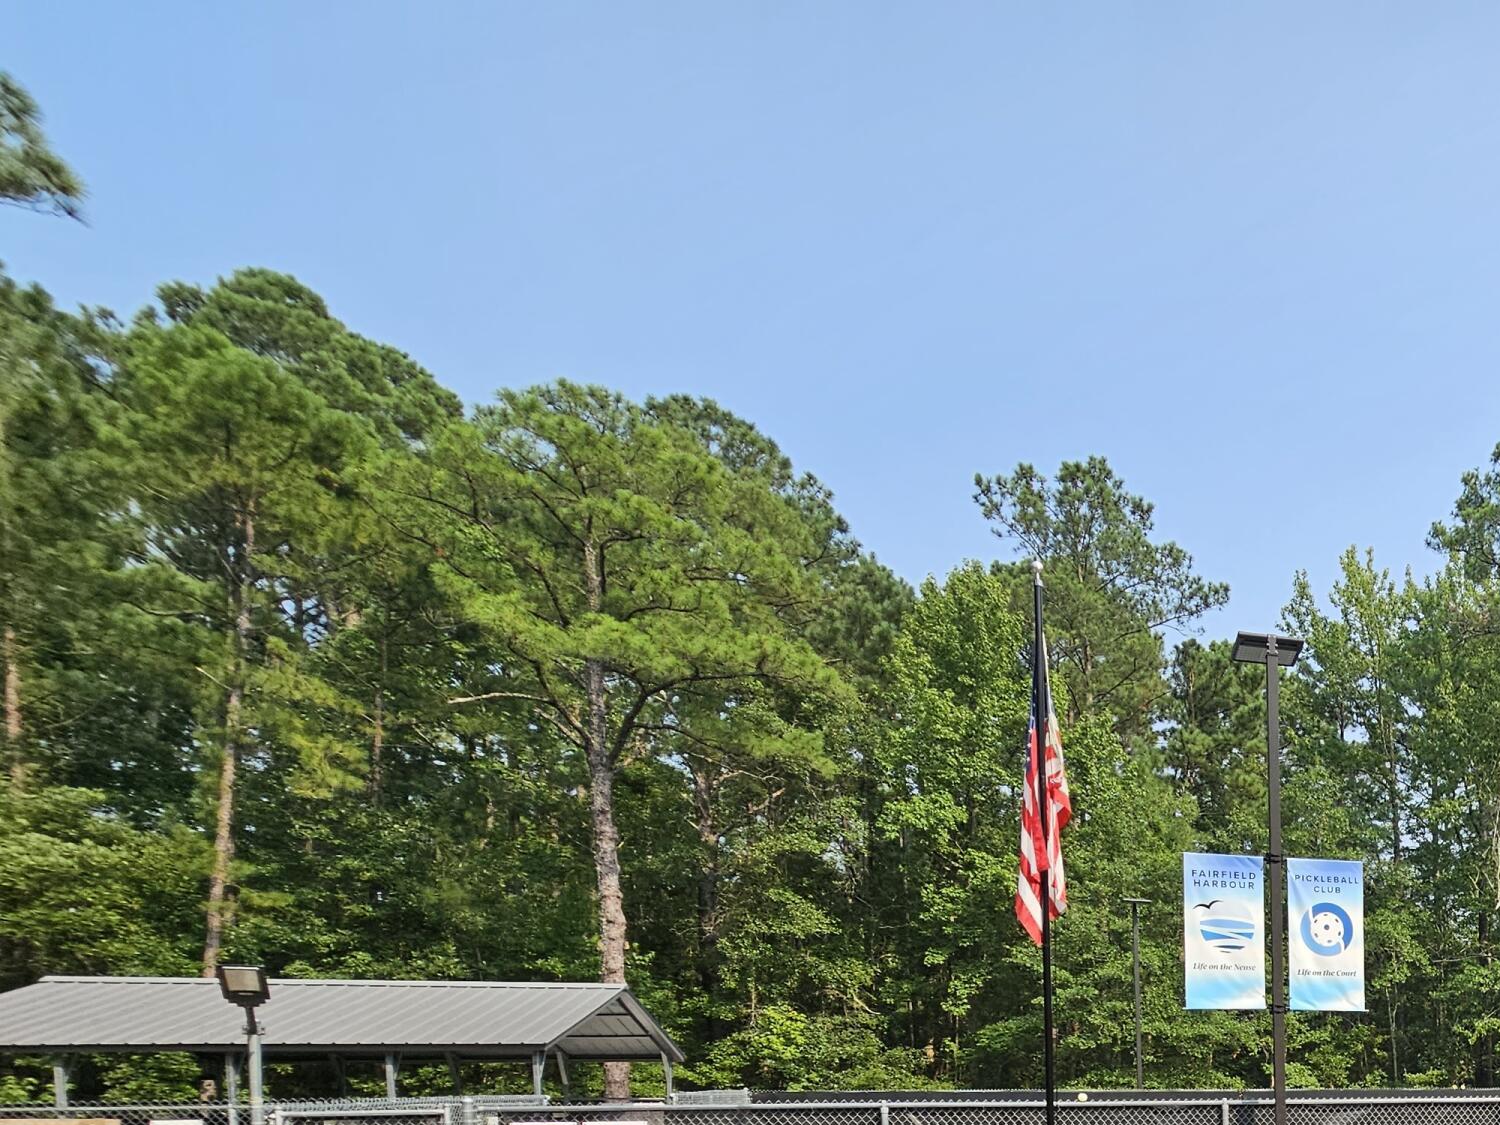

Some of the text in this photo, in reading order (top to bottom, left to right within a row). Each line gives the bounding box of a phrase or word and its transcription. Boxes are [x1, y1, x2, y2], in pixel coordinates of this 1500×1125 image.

[1191, 869, 1256, 880] FAIRFIELD
[1294, 874, 1359, 884] PICKLEBALL
[1193, 880, 1255, 889] HARBOUR
[1313, 886, 1341, 894] CLUB
[1193, 963, 1207, 971] Life
[1220, 963, 1233, 971] the
[1234, 963, 1256, 971] Neuse
[1297, 968, 1311, 977] Life
[1323, 969, 1335, 977] the
[1336, 969, 1357, 977] Court
